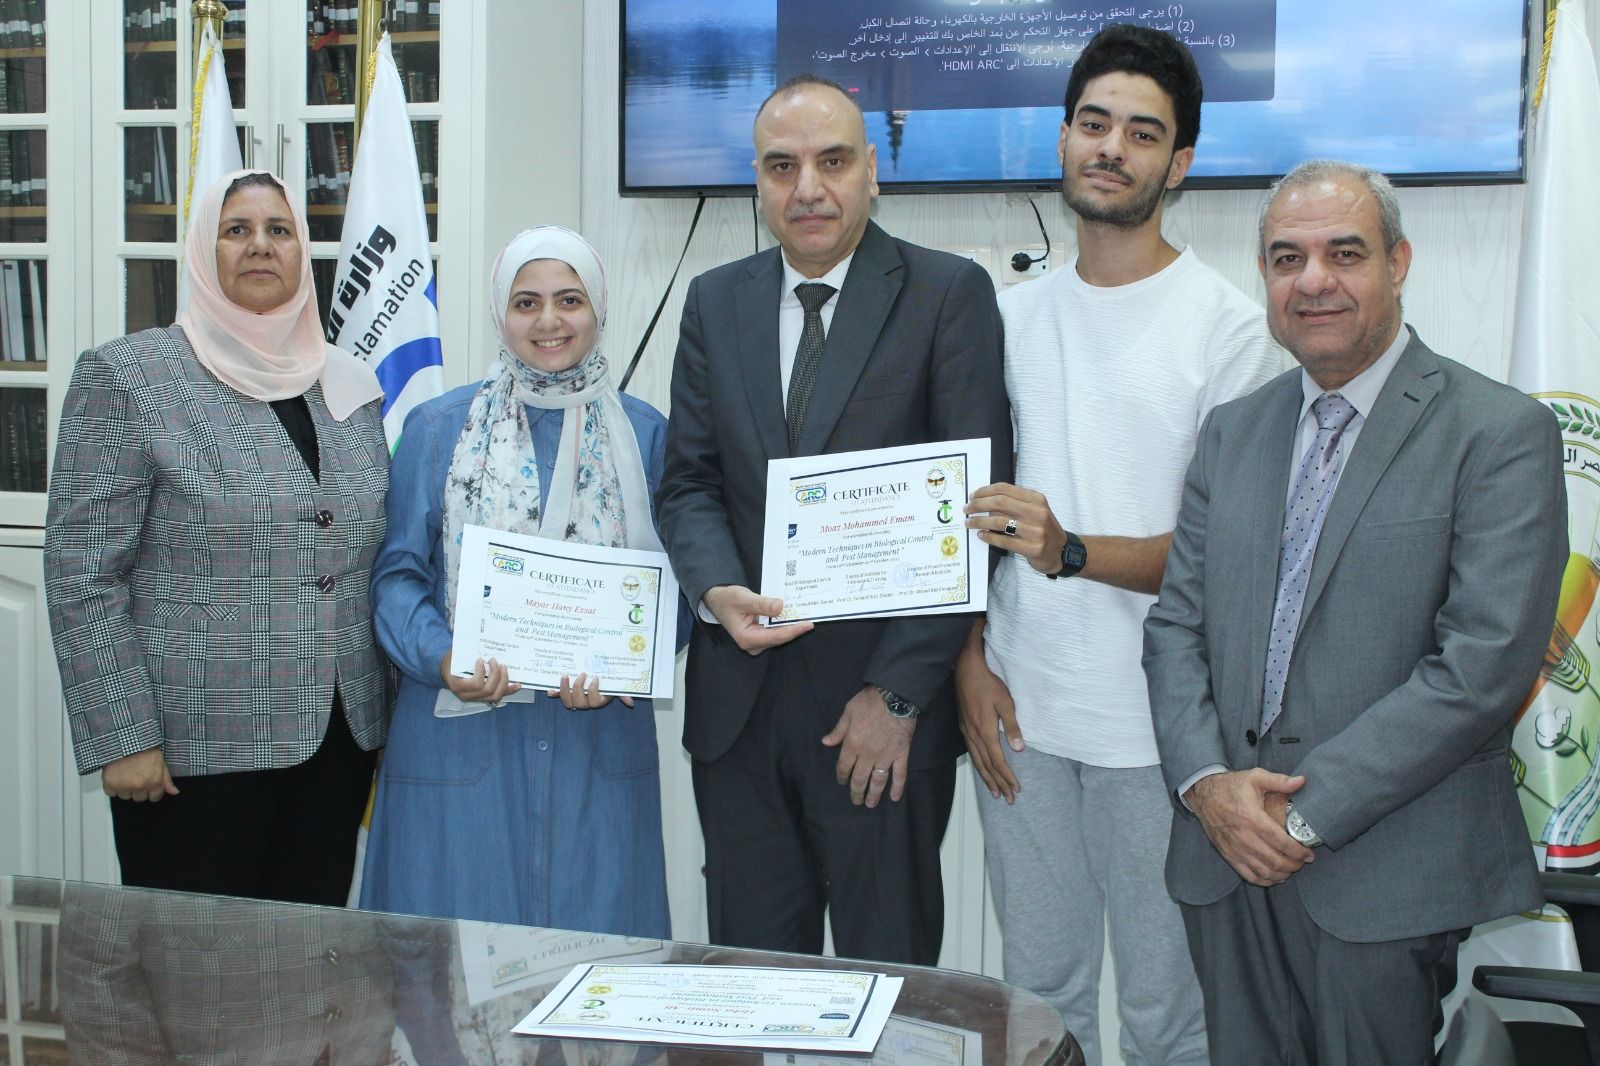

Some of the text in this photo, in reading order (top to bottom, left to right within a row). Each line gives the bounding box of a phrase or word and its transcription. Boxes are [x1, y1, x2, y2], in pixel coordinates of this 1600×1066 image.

[1055, 9, 1087, 21] توصيل
[1089, 11, 1103, 20] من
[1106, 7, 1135, 20] التحقق
[1168, 4, 1183, 18] (1)
[940, 14, 977, 27] بالكهرباء
[980, 11, 1016, 25] الخارجية
[1023, 26, 1050, 40] التحكم
[1054, 26, 1076, 38] جهاز
[1078, 24, 1095, 37] على
[1177, 19, 1194, 34] (2)
[942, 31, 955, 41] بك
[957, 29, 986, 41] الخاص
[1006, 29, 1020, 39] عن
[1184, 35, 1215, 48] بالنسبة
[1218, 34, 1236, 48] (3)
[851, 50, 876, 62] مخرج
[890, 47, 919, 59] الصوت
[337, 225, 397, 311] وزارة
[354, 259, 425, 362] lamation
[833, 482, 911, 502] CERTIFICATE
[820, 515, 915, 534] Moaz Mohammed Emam
[530, 570, 606, 589] CERTIFICATE
[525, 598, 551, 611] Mayar
